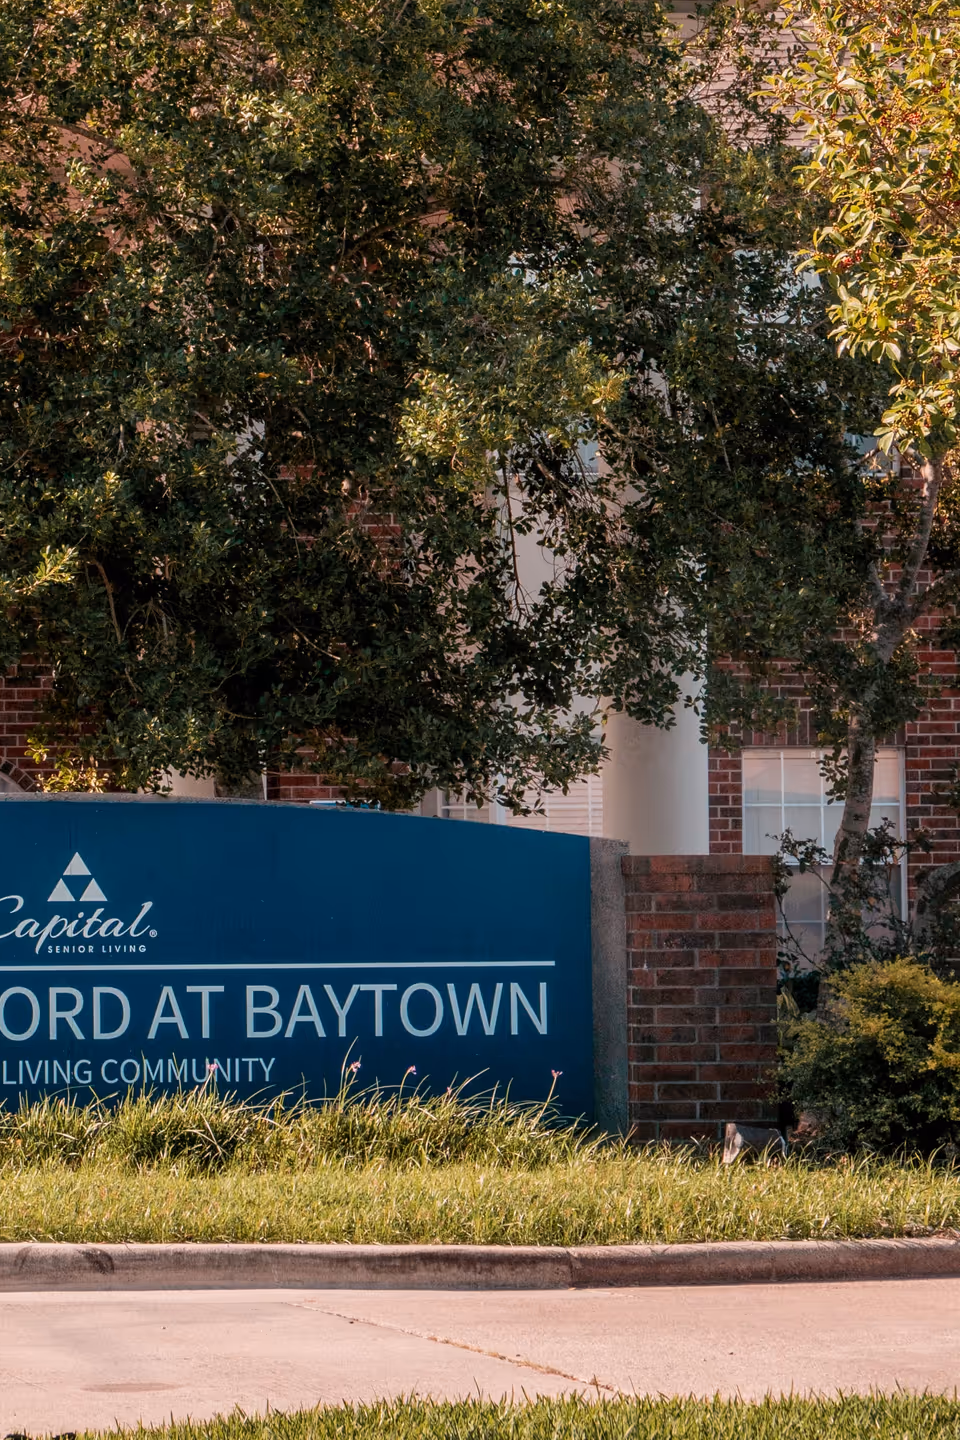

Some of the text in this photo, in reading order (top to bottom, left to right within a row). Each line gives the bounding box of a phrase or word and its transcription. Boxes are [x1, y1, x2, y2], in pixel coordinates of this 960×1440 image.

[47, 944, 147, 953] SENIOR LIVING
[147, 985, 225, 1039] AT
[246, 982, 548, 1038] BAYTOWN
[2, 1059, 93, 1085] LIVING
[100, 1057, 276, 1085] COMMUNITY
